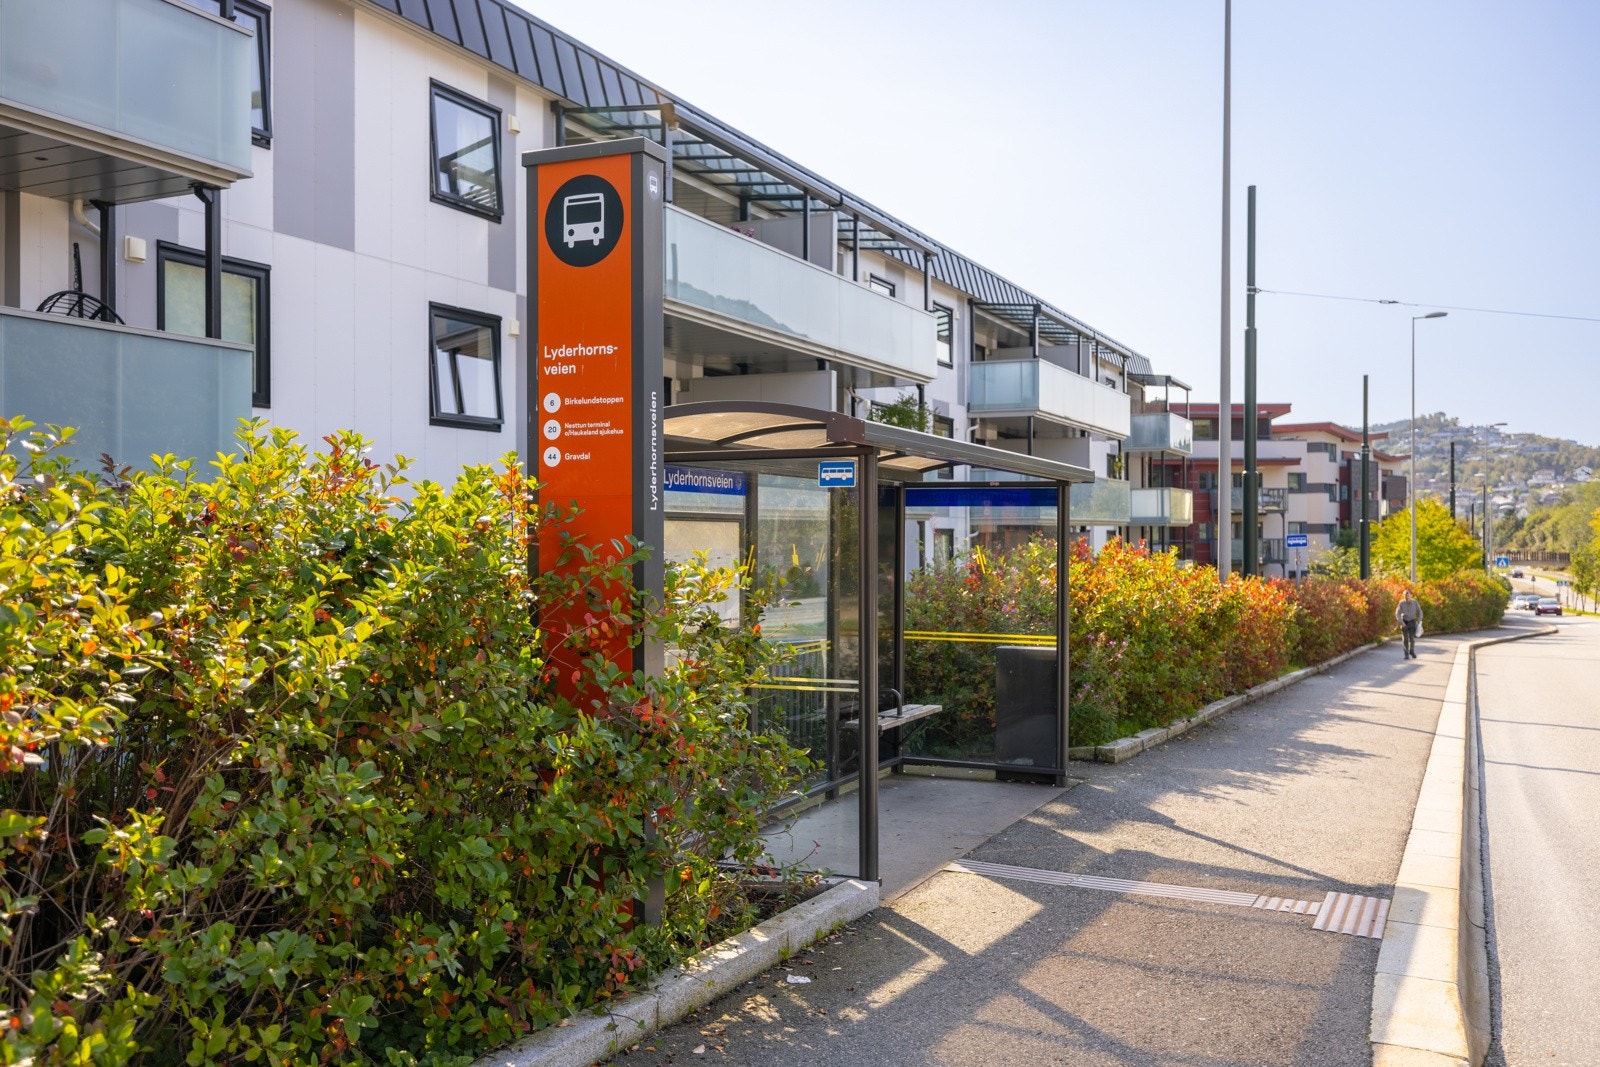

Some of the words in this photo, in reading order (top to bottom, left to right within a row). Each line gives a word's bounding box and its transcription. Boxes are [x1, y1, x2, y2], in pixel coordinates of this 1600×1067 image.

[544, 343, 618, 360] Lyderhorns-
[544, 362, 576, 375] veien
[549, 399, 555, 407] 6
[564, 397, 624, 406] Birkelundstoppen
[564, 452, 591, 460] Gravdal
[650, 391, 658, 511] Lyderhornsveien
[663, 468, 734, 489] Lyderhornsveien
